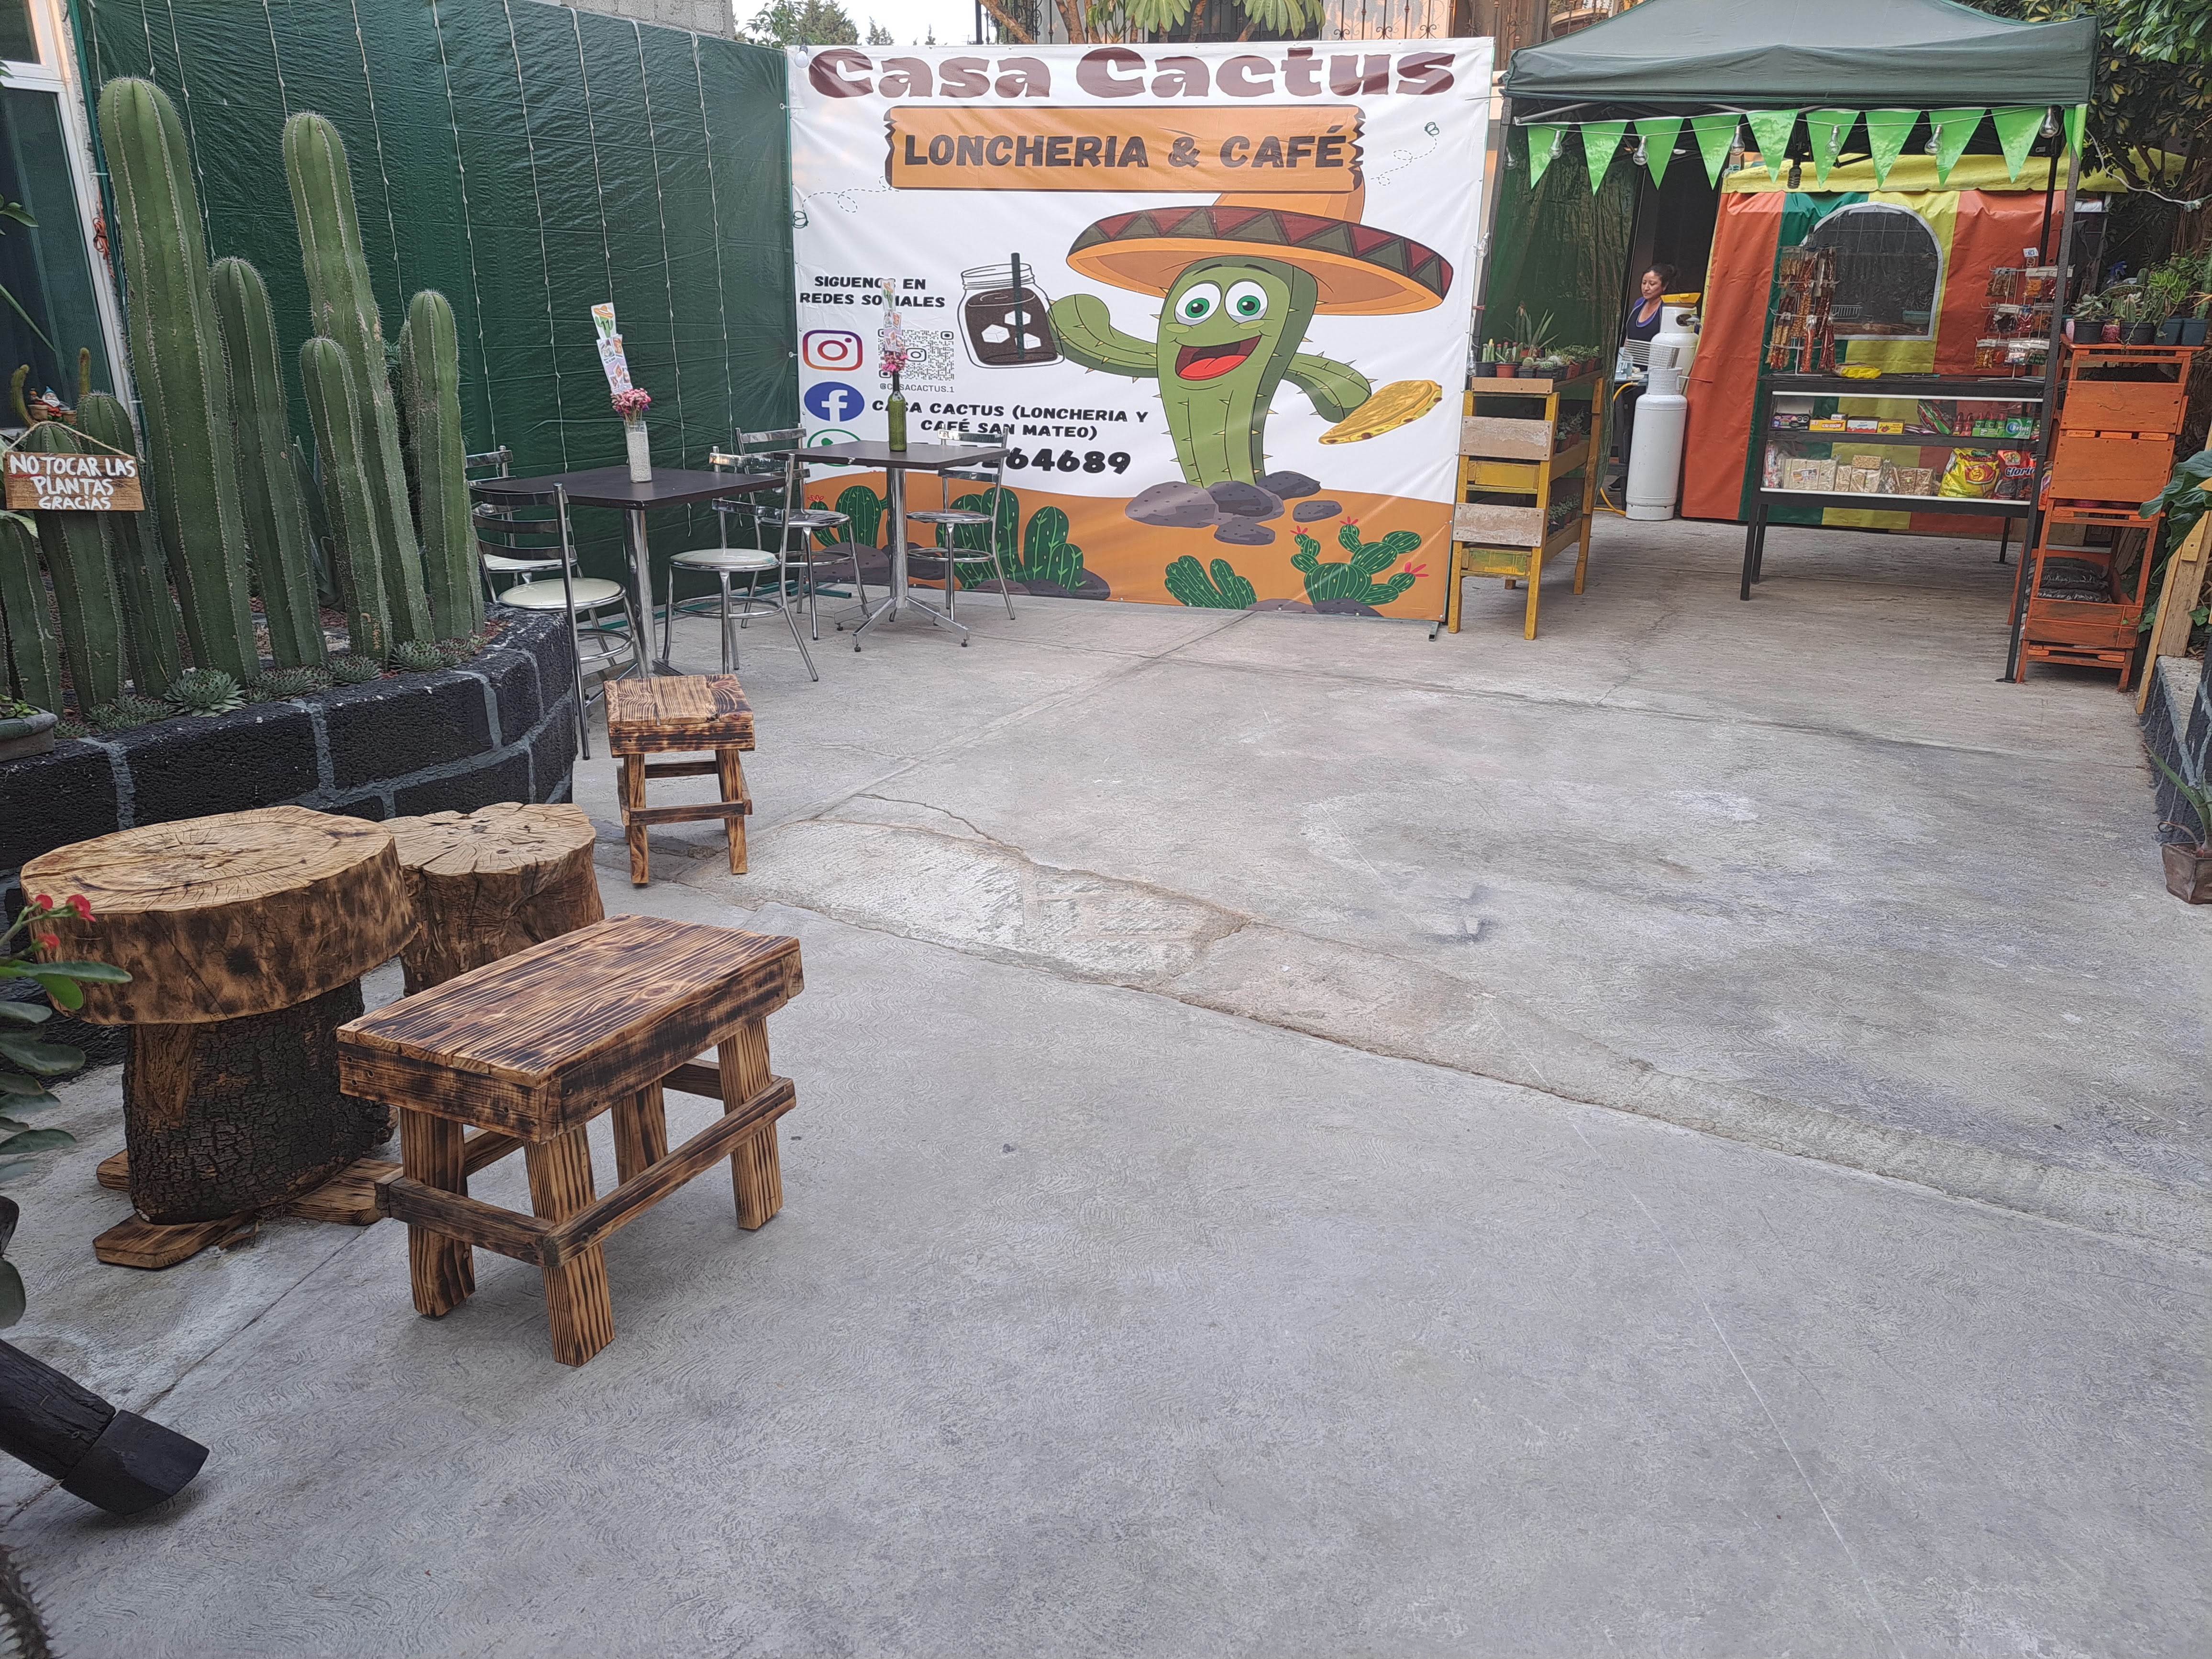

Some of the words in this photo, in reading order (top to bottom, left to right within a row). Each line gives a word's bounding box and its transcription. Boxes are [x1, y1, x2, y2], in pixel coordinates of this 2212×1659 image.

[808, 48, 1051, 99] Casa
[1076, 47, 1455, 99] Cactus
[905, 134, 1149, 168] LONCHERIA
[1168, 135, 1201, 168] &
[1219, 125, 1348, 168] CAFÉ
[902, 278, 926, 290] EN
[800, 292, 854, 305] REDES
[861, 295, 945, 308] SOIALES
[880, 383, 954, 393] @CSACACTUS.1
[872, 400, 922, 413] CA
[929, 403, 1004, 417] CACTUS
[1013, 405, 1128, 422] (LONCHERIA
[1136, 411, 1149, 423] Y
[920, 418, 970, 432] CAFÉ
[977, 422, 1015, 435] SAN
[1022, 424, 1097, 441] MATEO)
[10, 453, 39, 475] NO
[37, 456, 102, 477] TOCAR
[105, 458, 136, 477] LAS
[30, 476, 114, 495] PLANTAS
